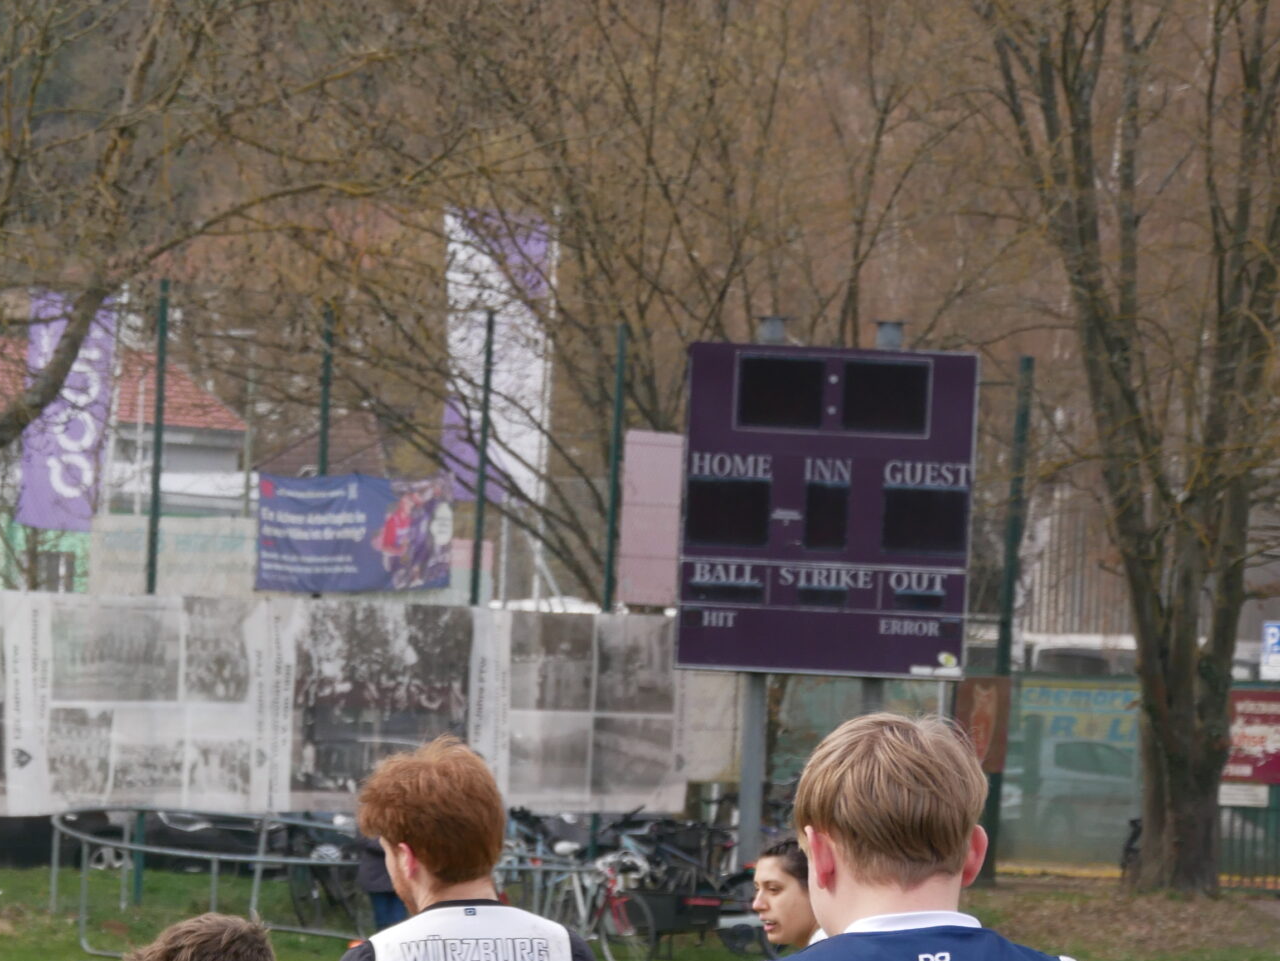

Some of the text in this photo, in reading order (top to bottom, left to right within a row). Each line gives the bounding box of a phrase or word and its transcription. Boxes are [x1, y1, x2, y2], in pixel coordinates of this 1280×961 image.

[692, 452, 773, 478] HOME
[804, 457, 852, 482] INN
[884, 460, 972, 487] GUEST
[692, 563, 760, 584] BALL
[779, 566, 874, 590] STRIKE
[889, 572, 948, 592] OUT
[702, 610, 739, 628] HIT
[879, 618, 940, 637] ERROR
